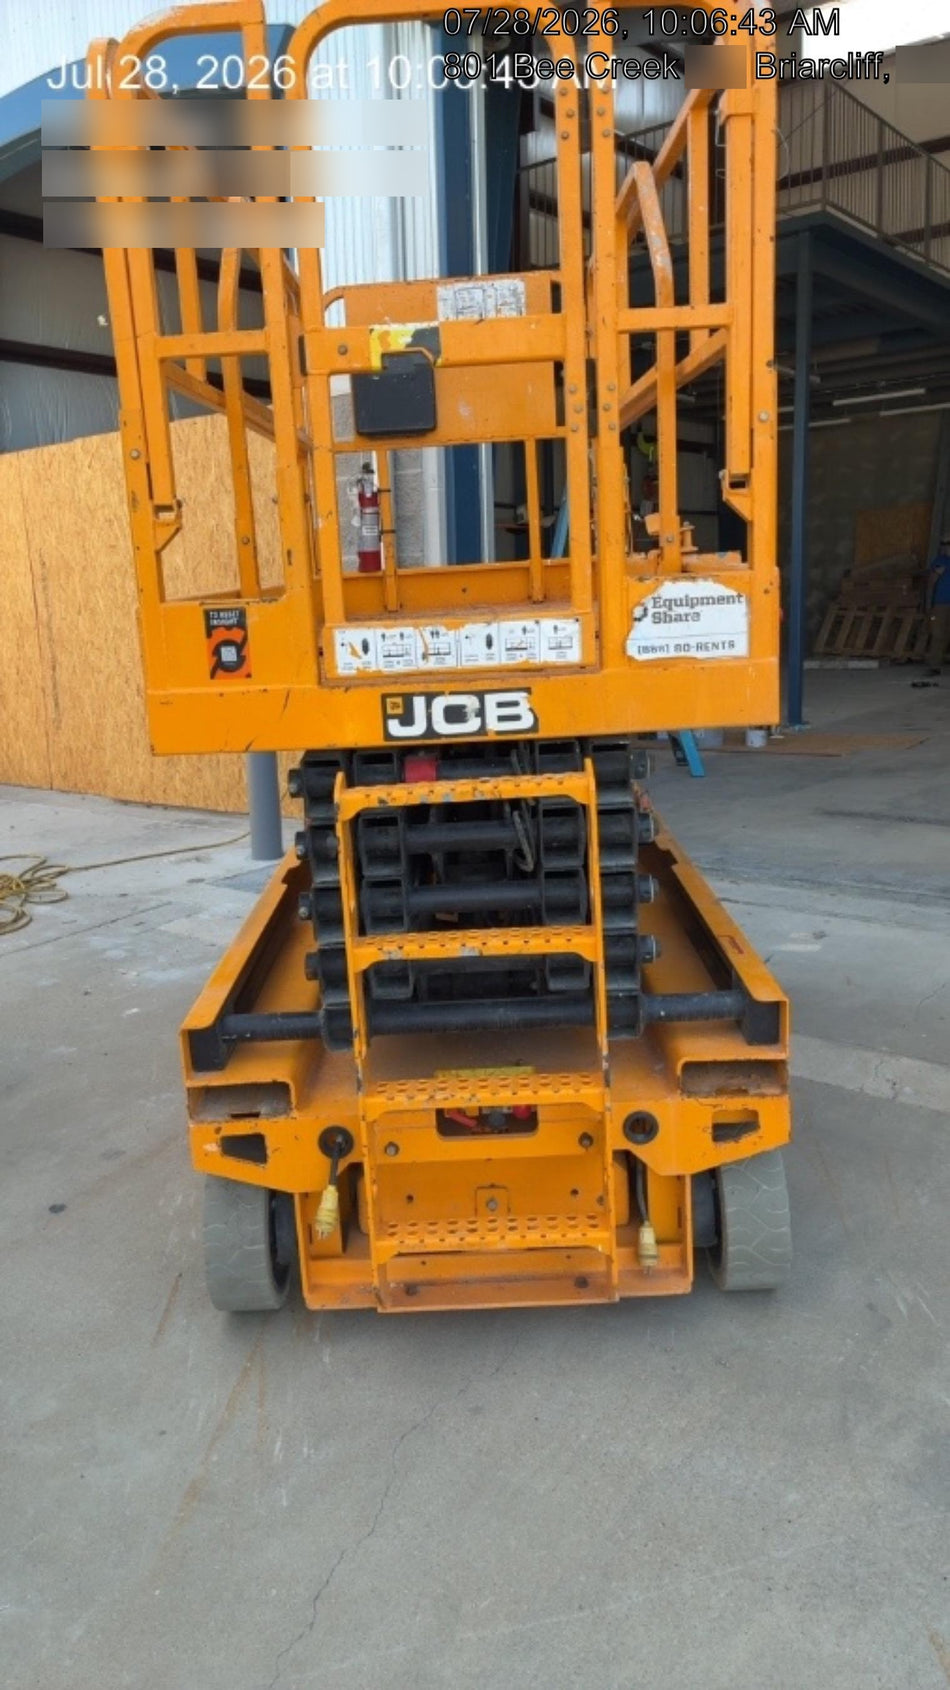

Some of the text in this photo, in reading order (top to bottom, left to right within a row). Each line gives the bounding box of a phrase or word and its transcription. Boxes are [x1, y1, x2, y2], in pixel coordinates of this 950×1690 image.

[651, 592, 744, 611] Equipment
[651, 611, 702, 625] Share
[386, 691, 534, 737] JCB
